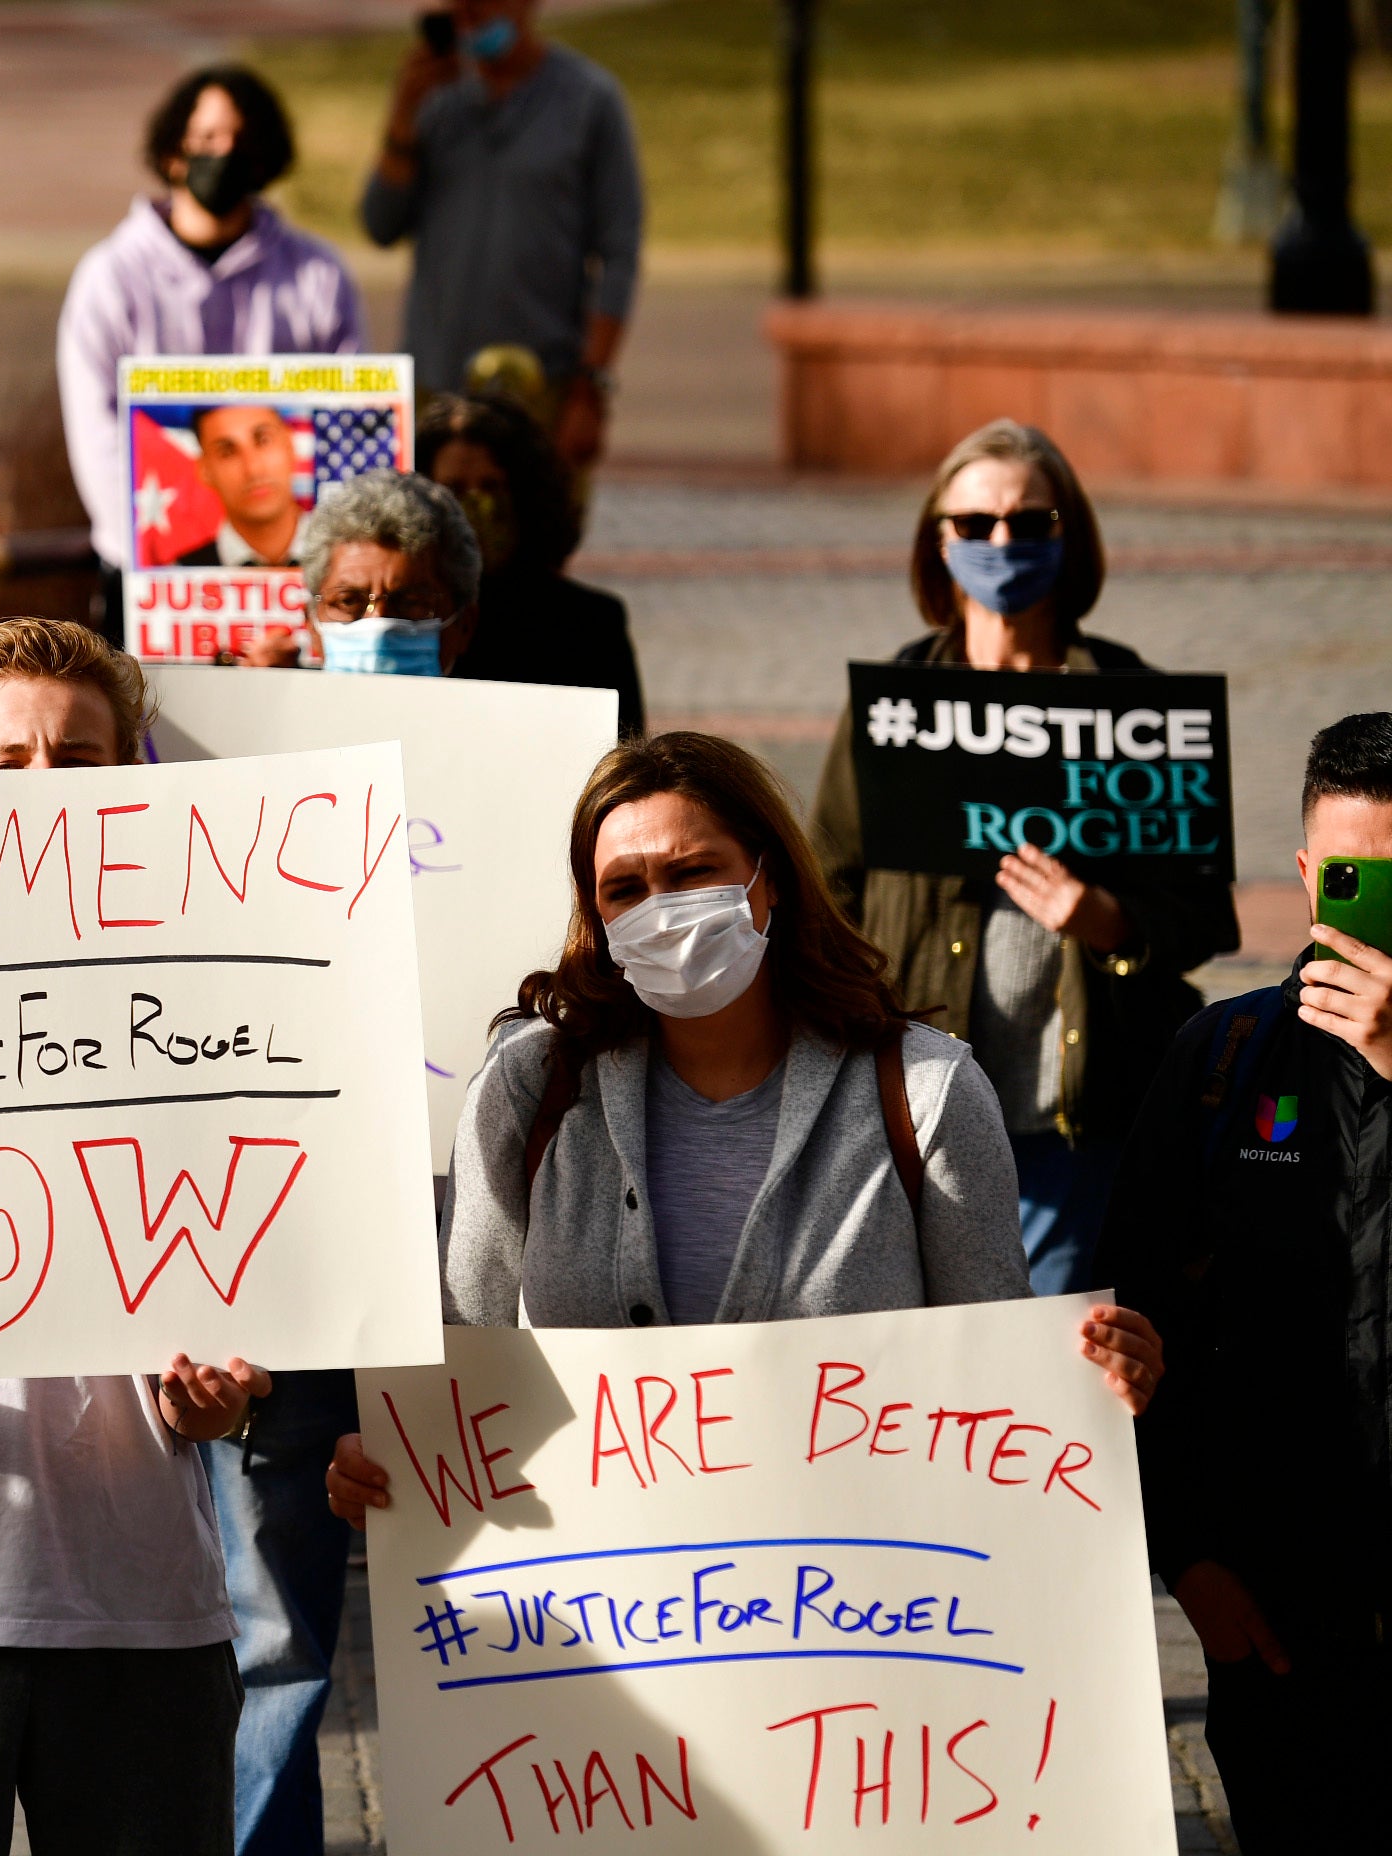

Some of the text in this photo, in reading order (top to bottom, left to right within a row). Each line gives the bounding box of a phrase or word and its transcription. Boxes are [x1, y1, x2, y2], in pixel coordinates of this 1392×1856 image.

[868, 697, 1213, 760] #JUSTICE
[1060, 760, 1219, 809] FOR
[961, 802, 1219, 857] ROGEL
[1239, 1148, 1300, 1163] NOTICIAS
[381, 1362, 1101, 1528] WE ARE BETTER
[445, 1699, 1057, 1843] THAN THIS!
